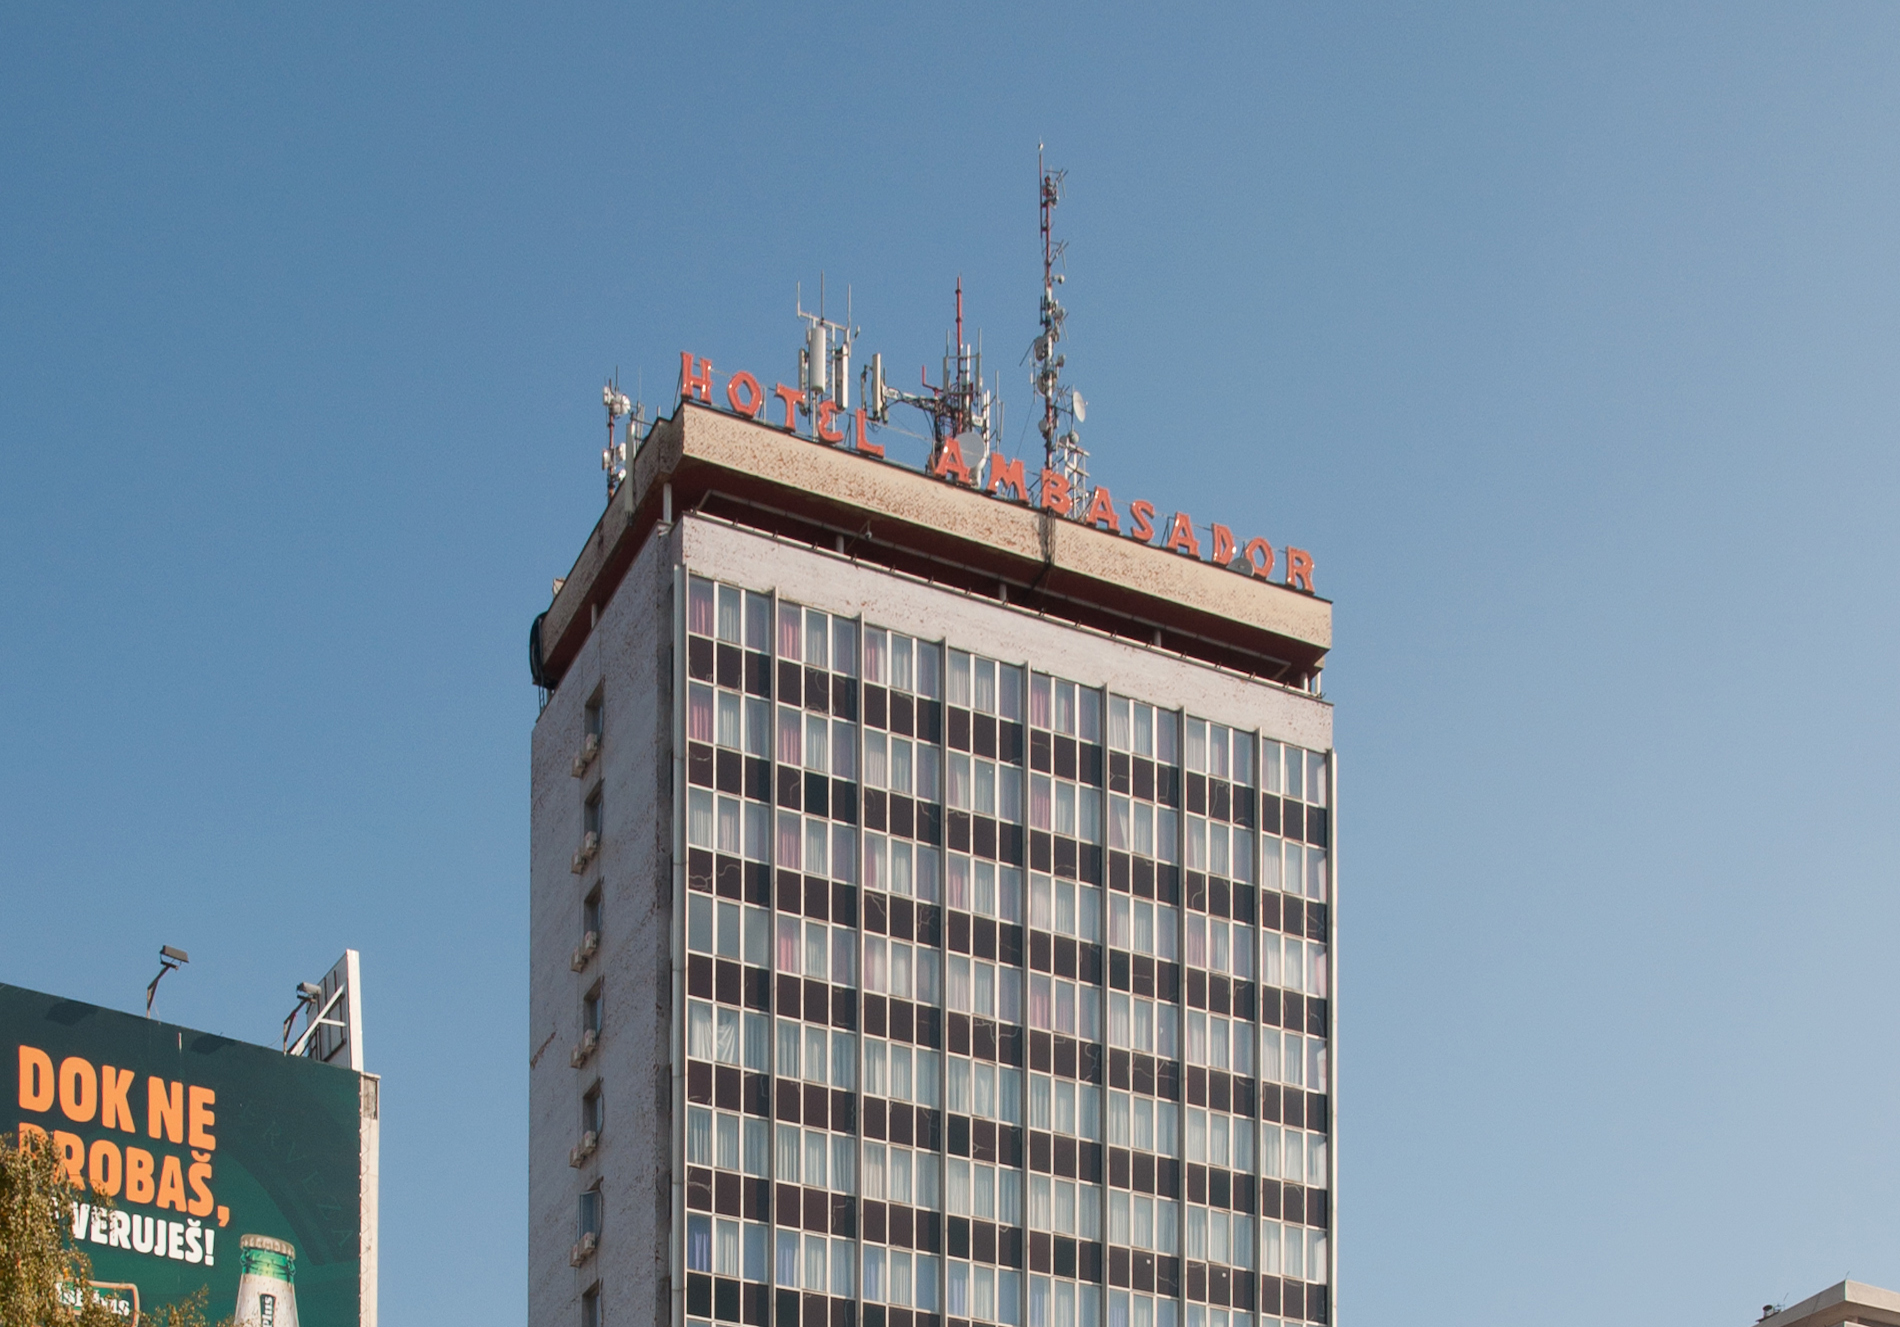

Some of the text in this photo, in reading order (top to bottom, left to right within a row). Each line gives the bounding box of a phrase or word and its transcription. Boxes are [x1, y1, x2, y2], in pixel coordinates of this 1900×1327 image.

[680, 352, 1316, 594] HOTEL AMBASADOR
[18, 1044, 217, 1152] DOK NE
